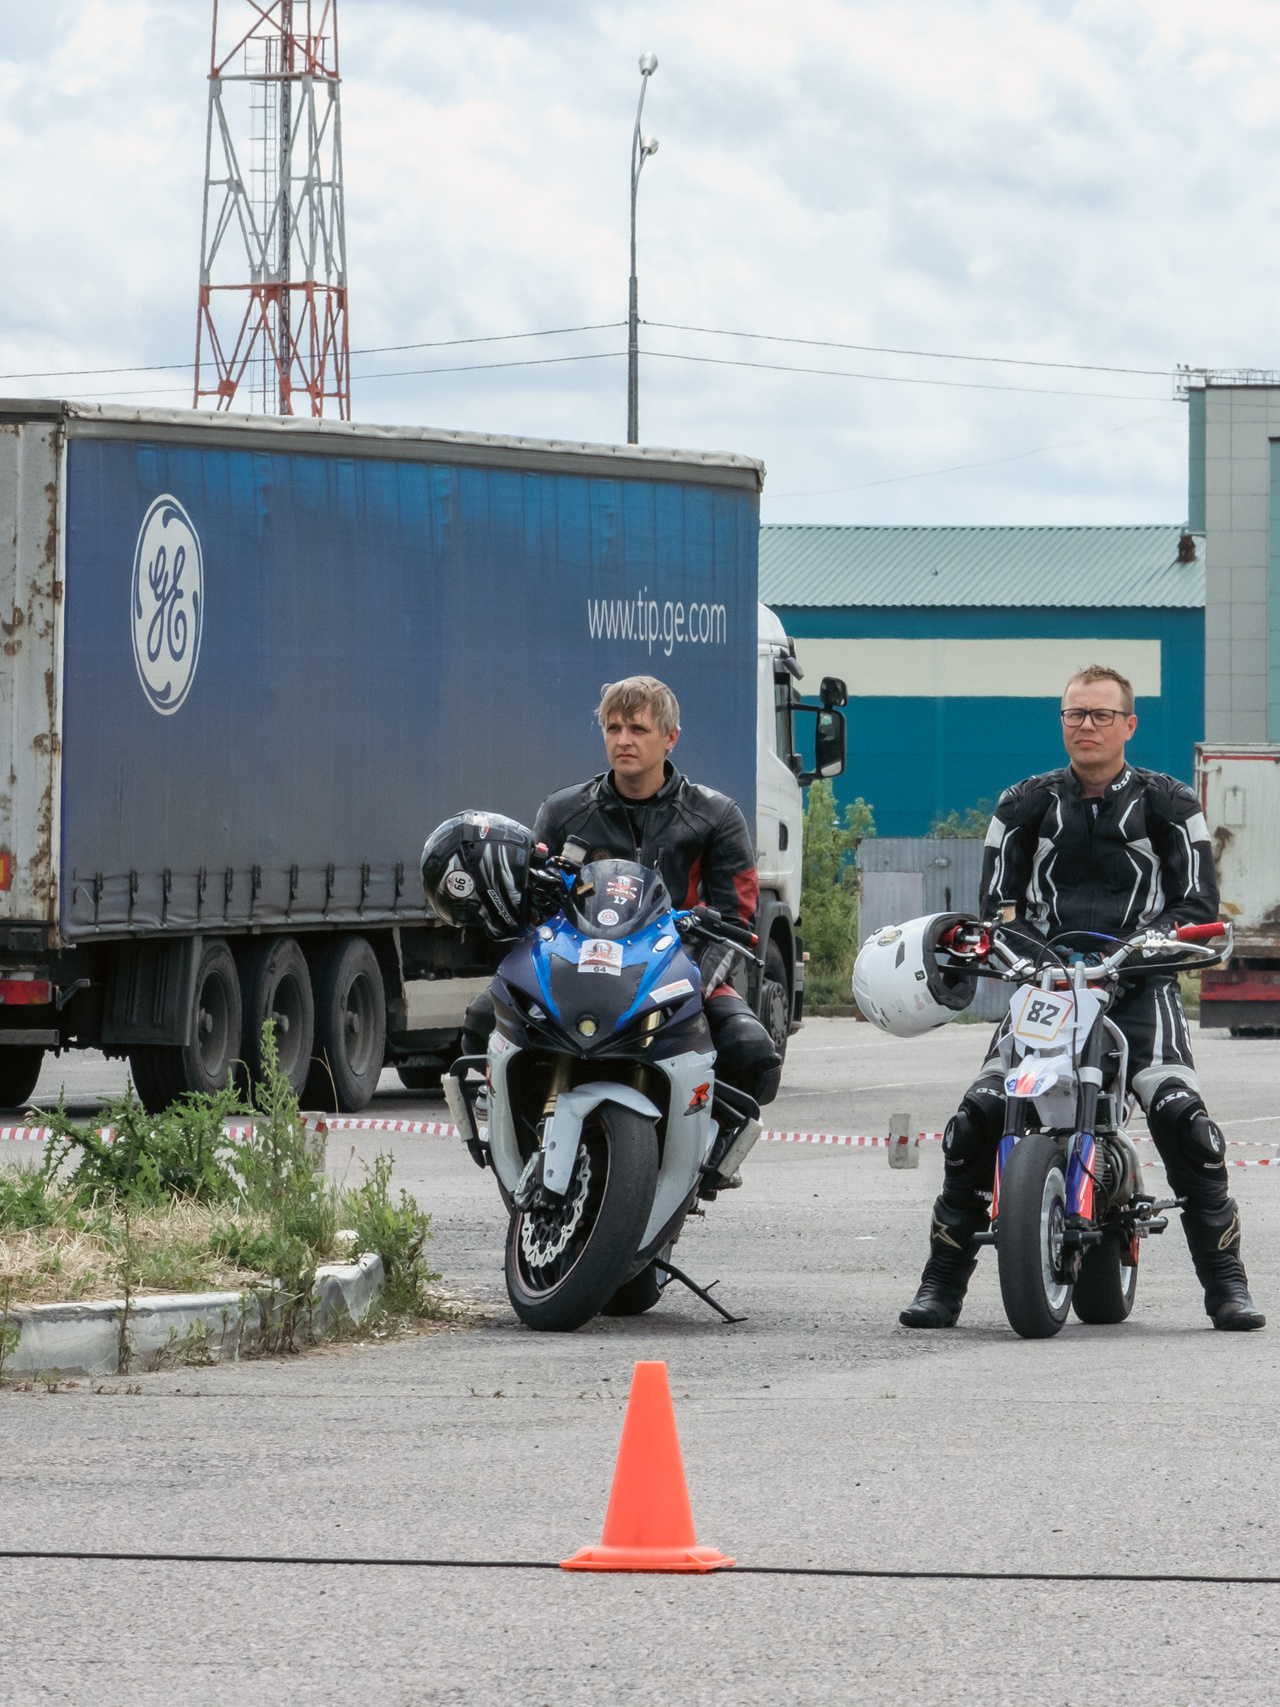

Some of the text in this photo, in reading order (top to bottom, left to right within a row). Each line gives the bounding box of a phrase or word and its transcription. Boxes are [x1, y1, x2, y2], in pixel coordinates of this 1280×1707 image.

[587, 586, 728, 657] www.tip.ge.com
[613, 895, 628, 906] 17
[1026, 999, 1061, 1027] 82
